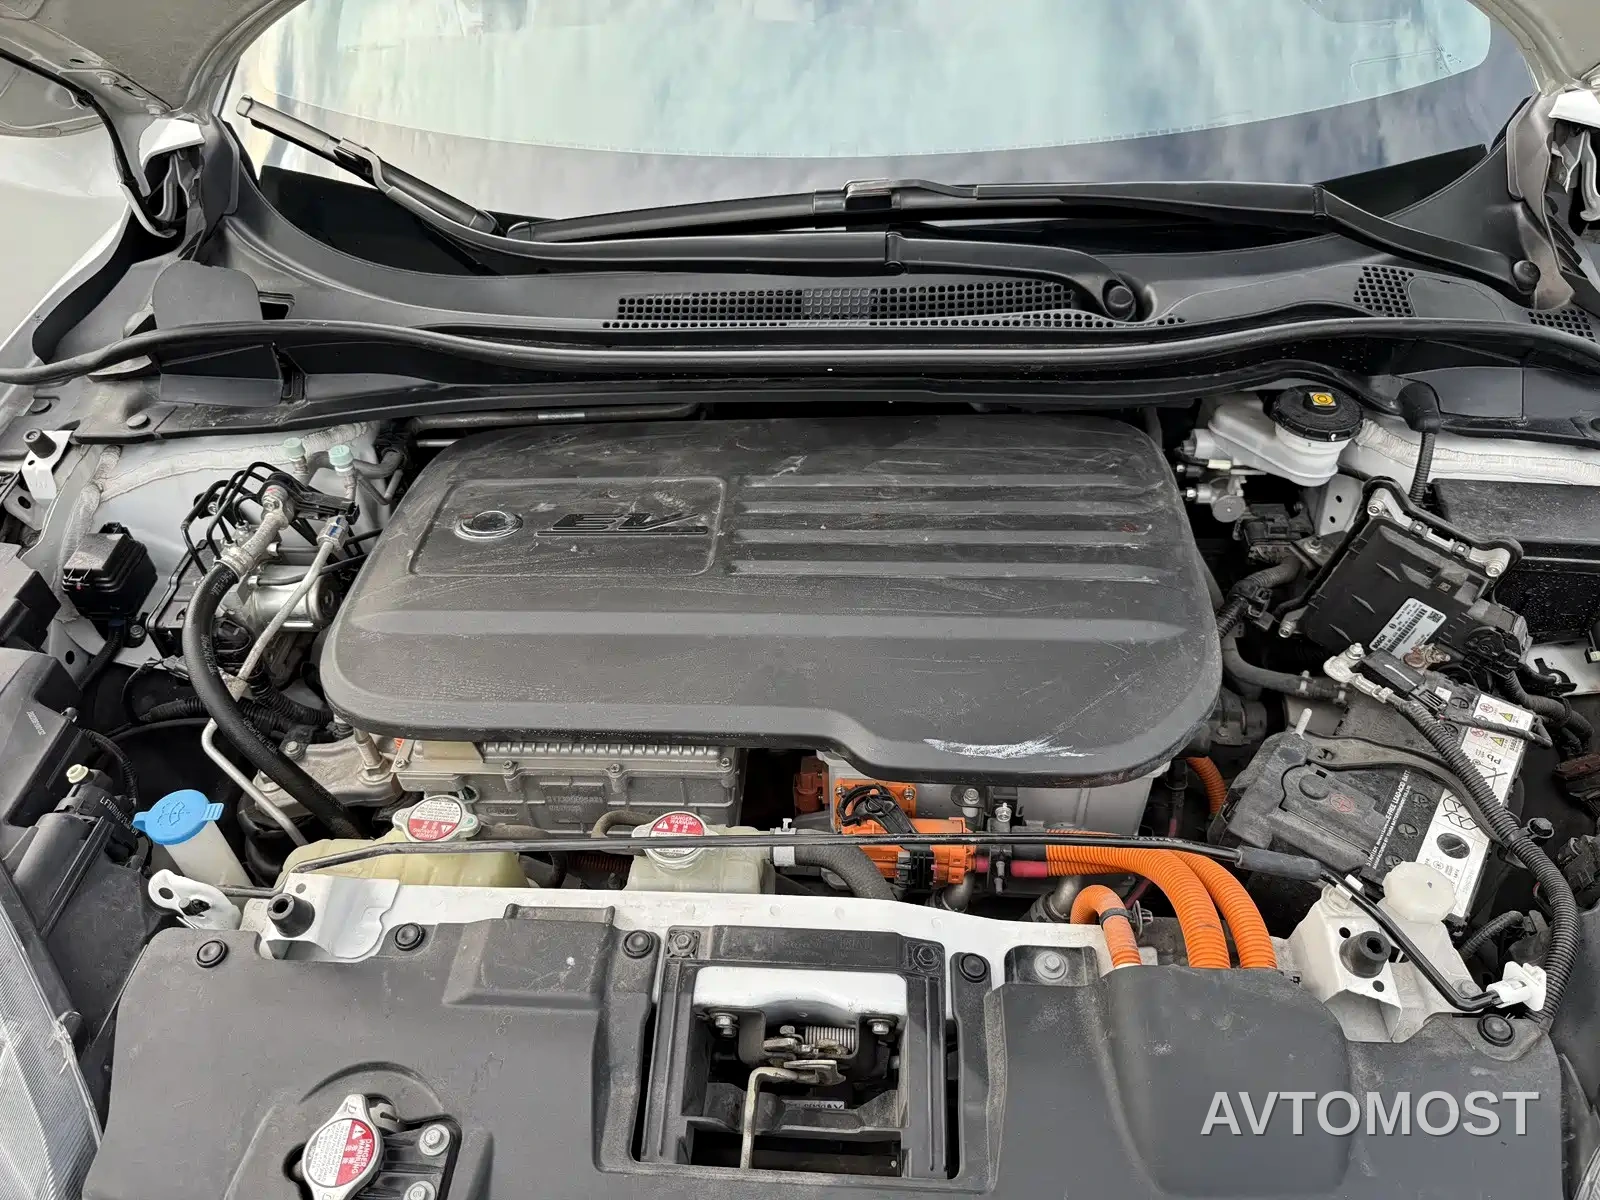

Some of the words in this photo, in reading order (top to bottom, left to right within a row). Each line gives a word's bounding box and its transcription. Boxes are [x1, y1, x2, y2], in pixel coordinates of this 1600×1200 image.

[1372, 633, 1387, 649] BOSCH
[1486, 753, 1502, 765] Pb
[352, 1140, 364, 1173] WARNING
[361, 1139, 372, 1167] DANGER
